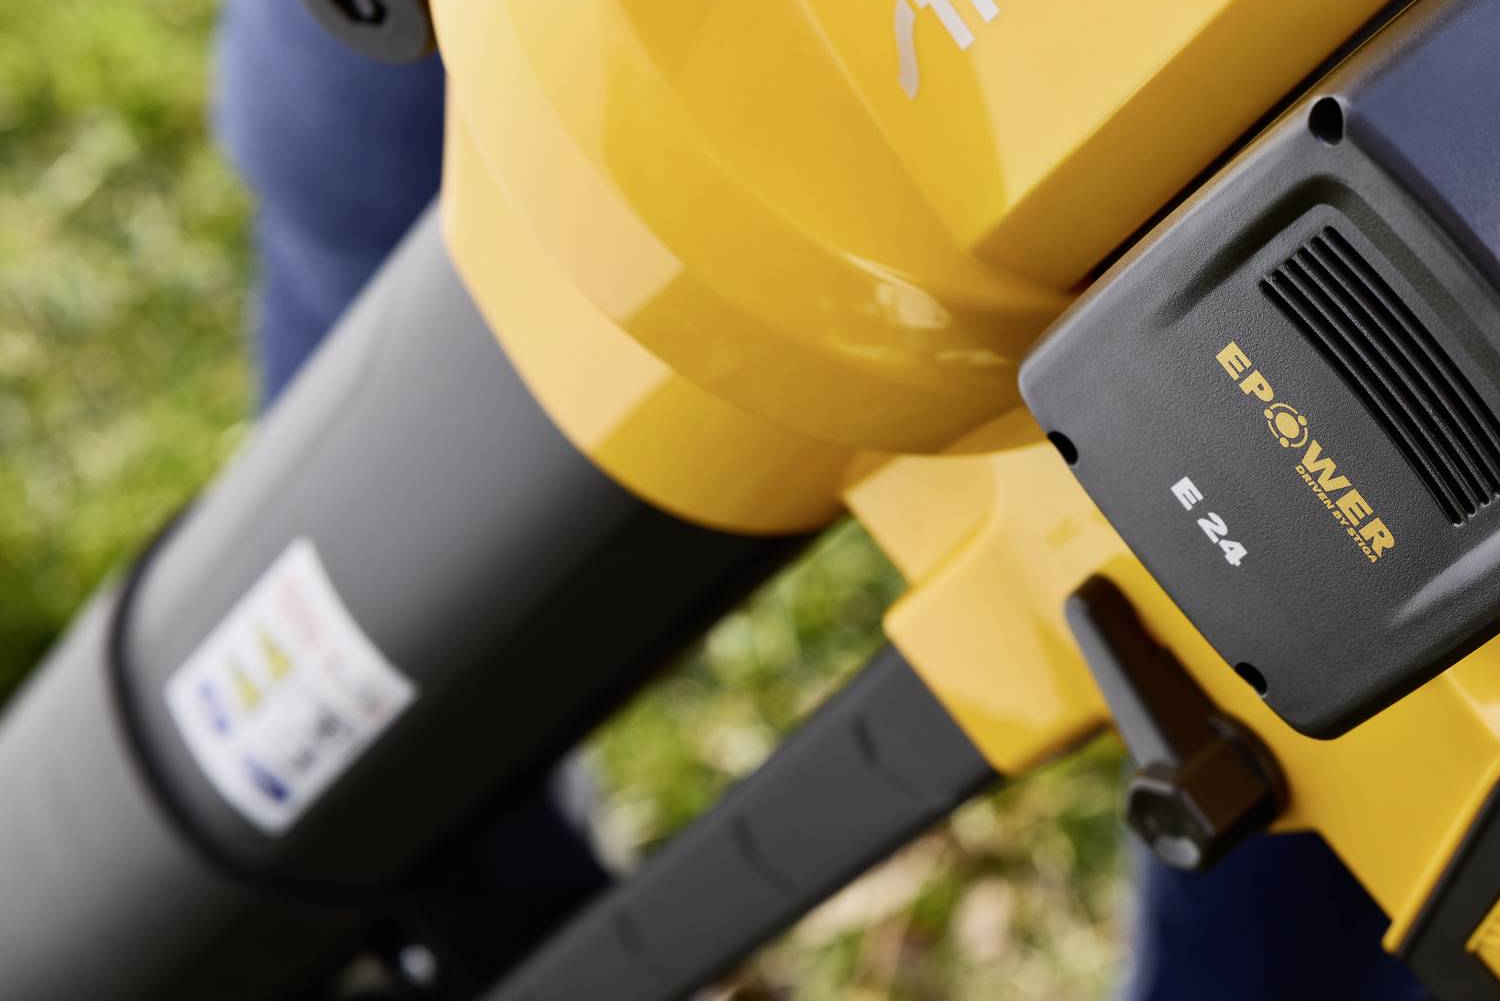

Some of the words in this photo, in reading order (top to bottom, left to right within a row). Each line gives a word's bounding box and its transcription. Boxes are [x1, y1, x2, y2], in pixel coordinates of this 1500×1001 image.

[1215, 341, 1395, 559] EPOWER
[1170, 476, 1204, 511] E
[1197, 512, 1247, 567] 24
[1295, 464, 1335, 510] DRIVEN
[1332, 510, 1349, 526] BY
[1347, 527, 1378, 563] STIGA
